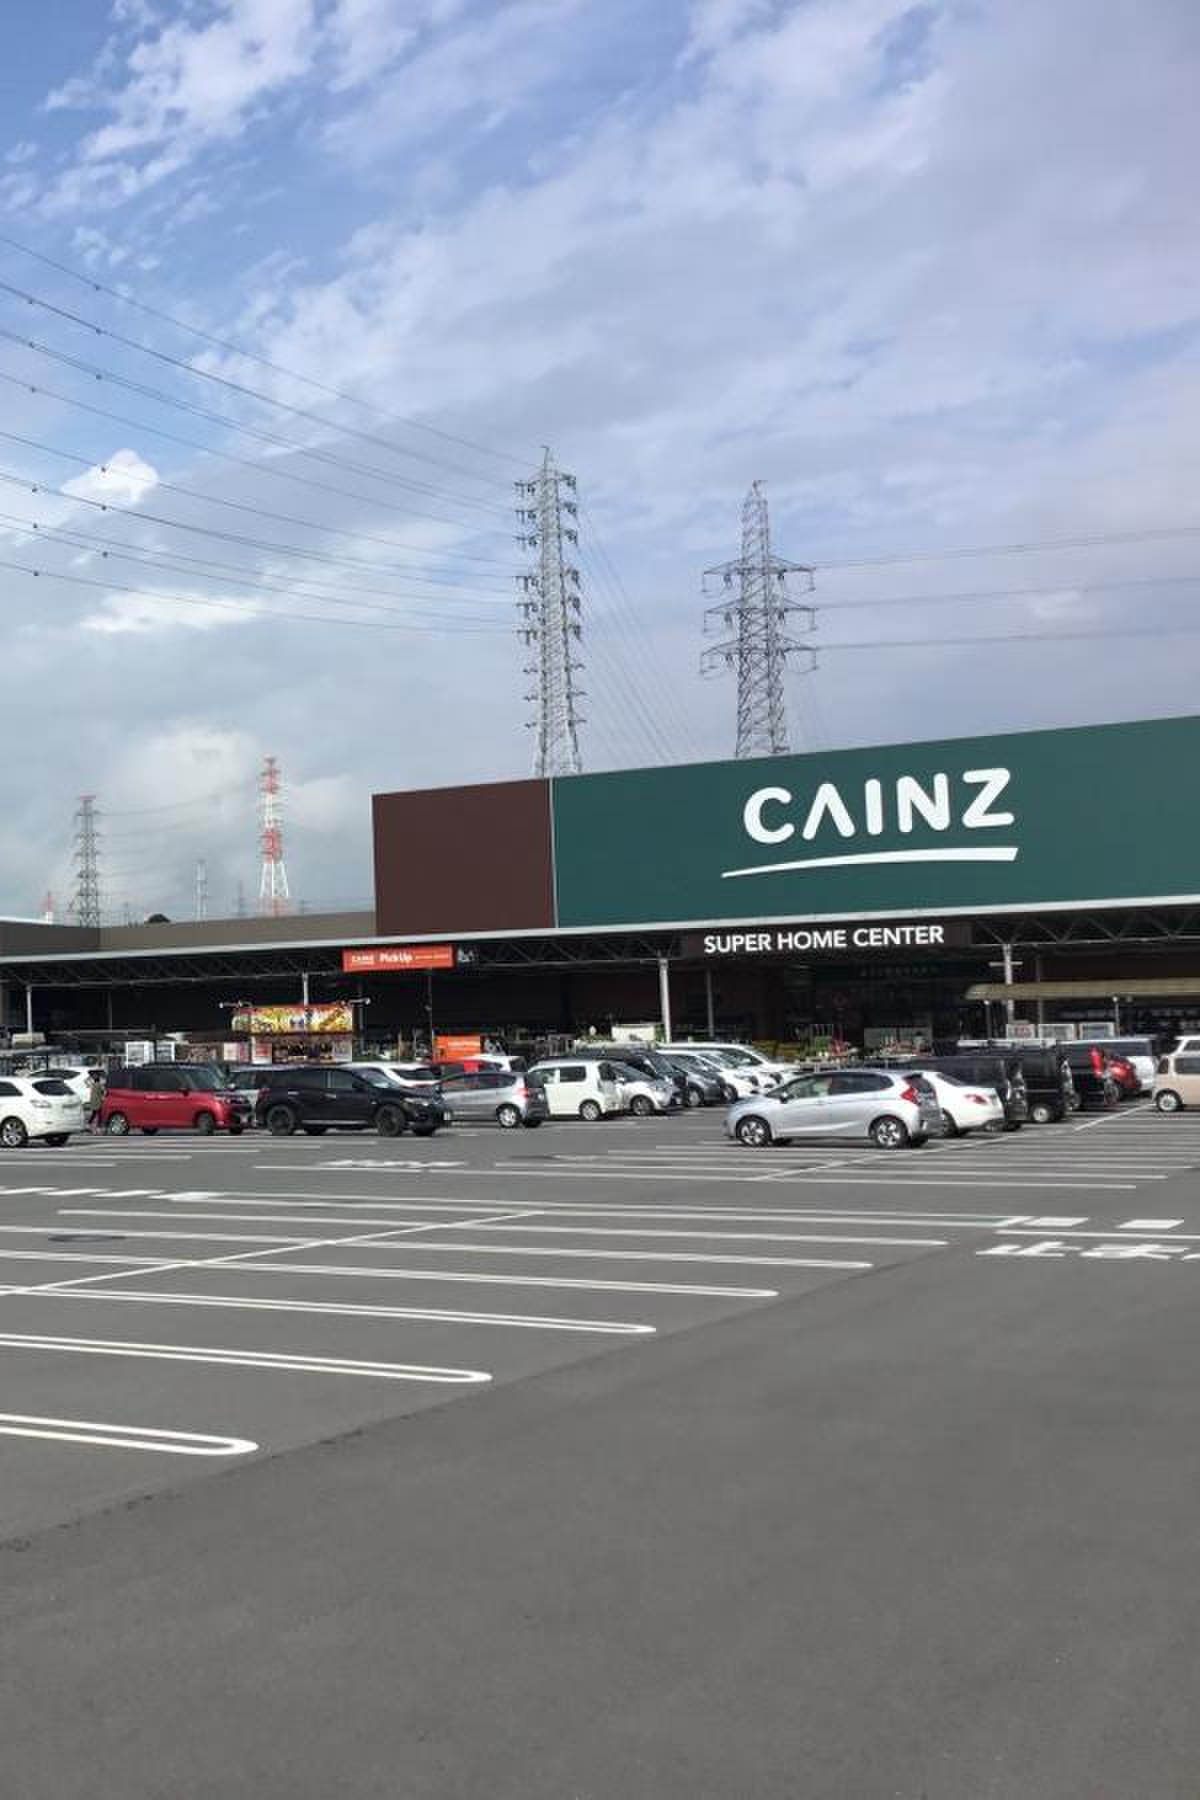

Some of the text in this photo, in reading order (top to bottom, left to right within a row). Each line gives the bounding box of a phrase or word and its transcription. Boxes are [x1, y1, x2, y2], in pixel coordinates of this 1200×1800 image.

[743, 768, 1015, 844] CAINZ
[704, 925, 945, 954] SUPER HOME CENTER
[975, 1241, 1200, 1262] 止ま
